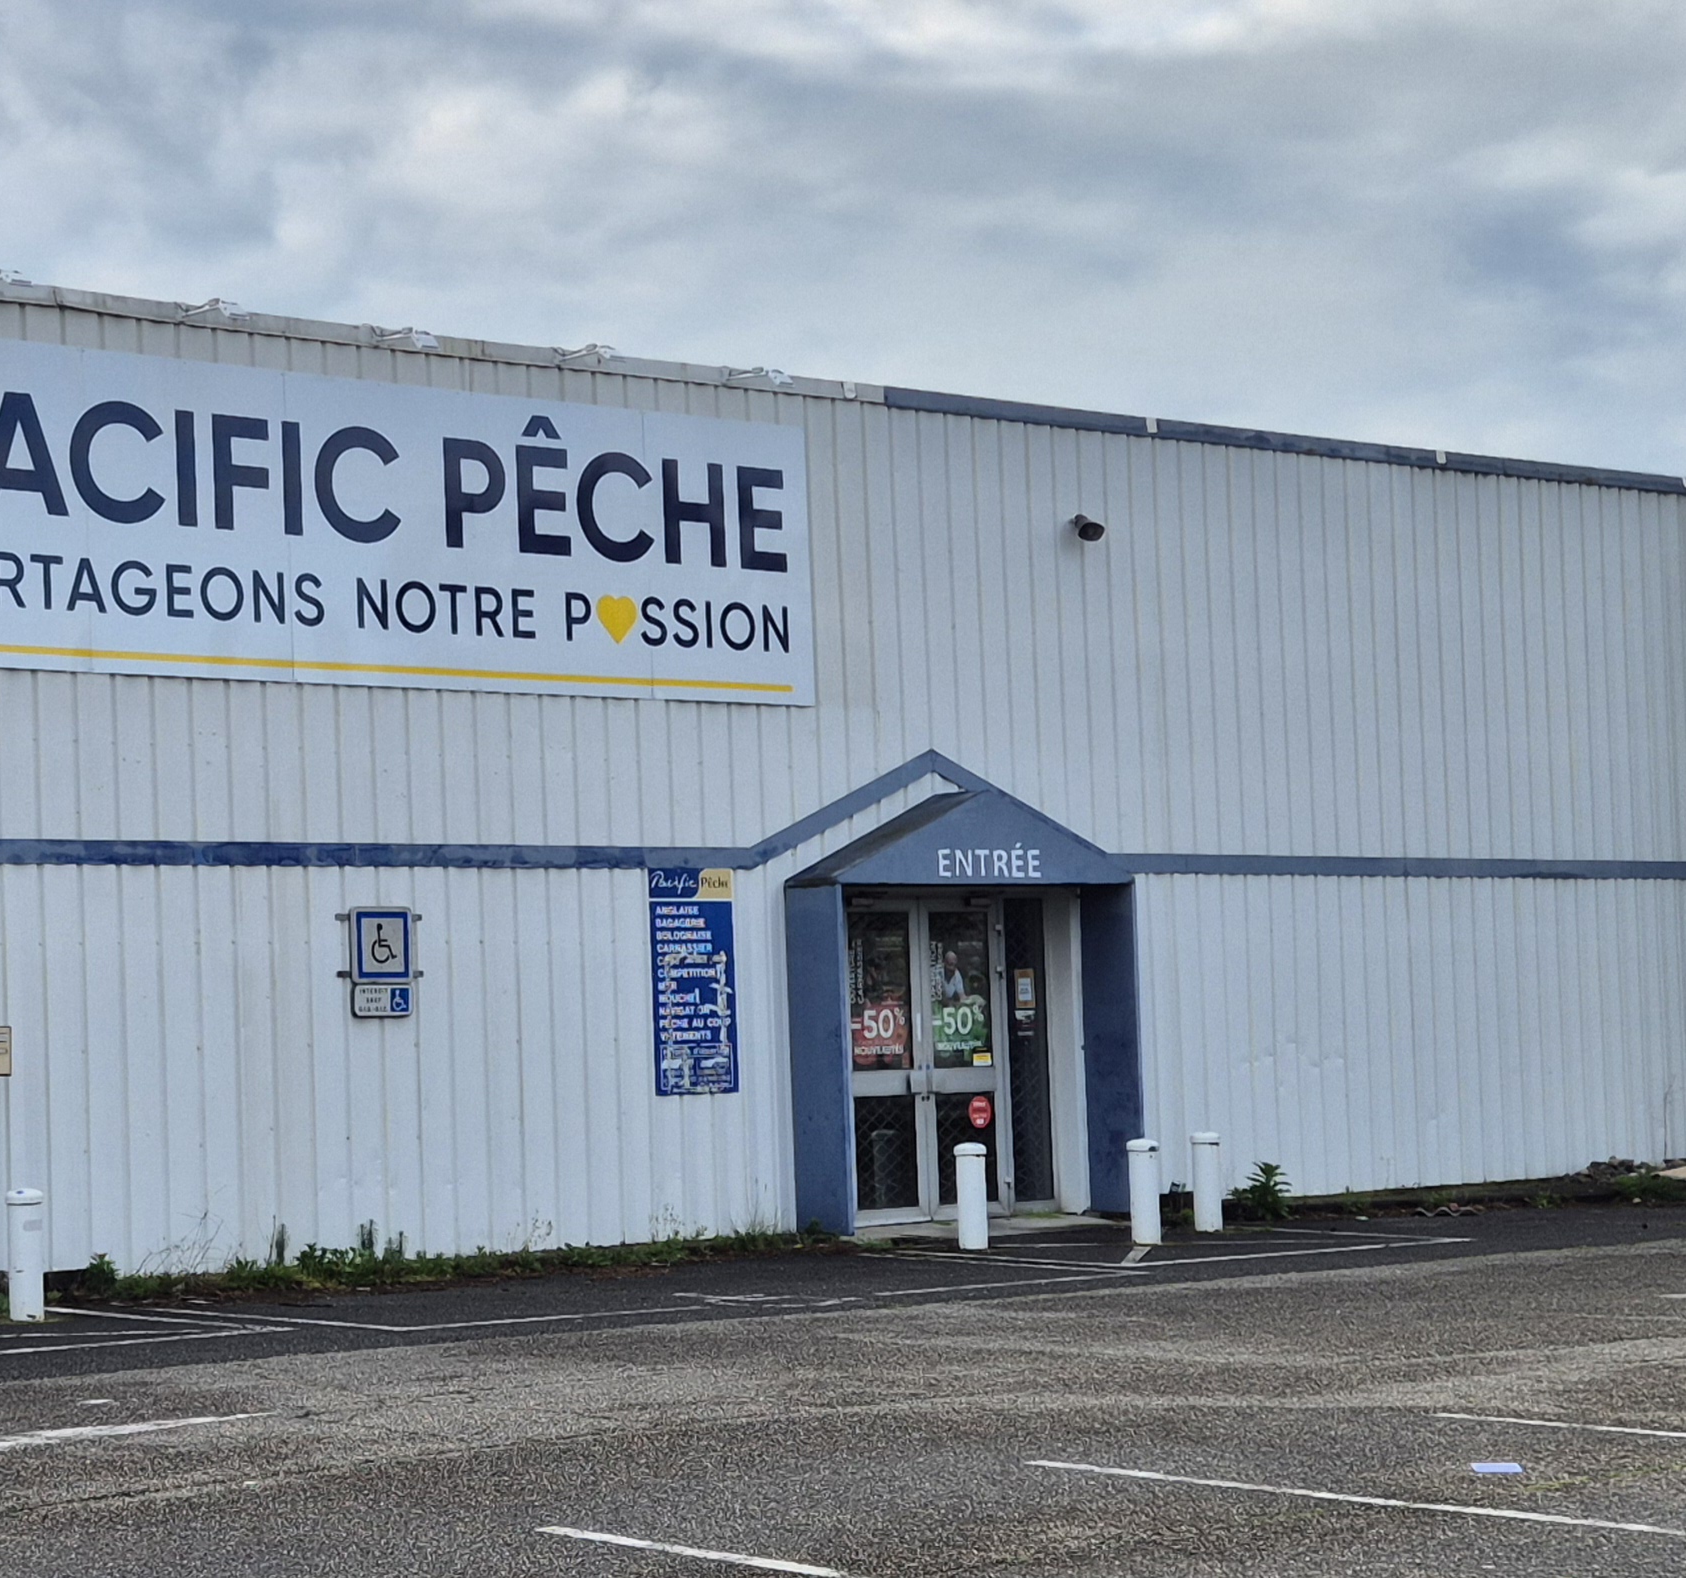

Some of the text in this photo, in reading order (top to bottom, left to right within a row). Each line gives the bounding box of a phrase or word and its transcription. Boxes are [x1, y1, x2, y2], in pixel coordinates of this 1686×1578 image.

[442, 415, 789, 573] PÊCHE
[357, 579, 536, 640] NOTRE
[564, 589, 791, 654] PSSION
[650, 871, 728, 895] Pacific Pêche
[937, 842, 1042, 878] ENTRÉE
